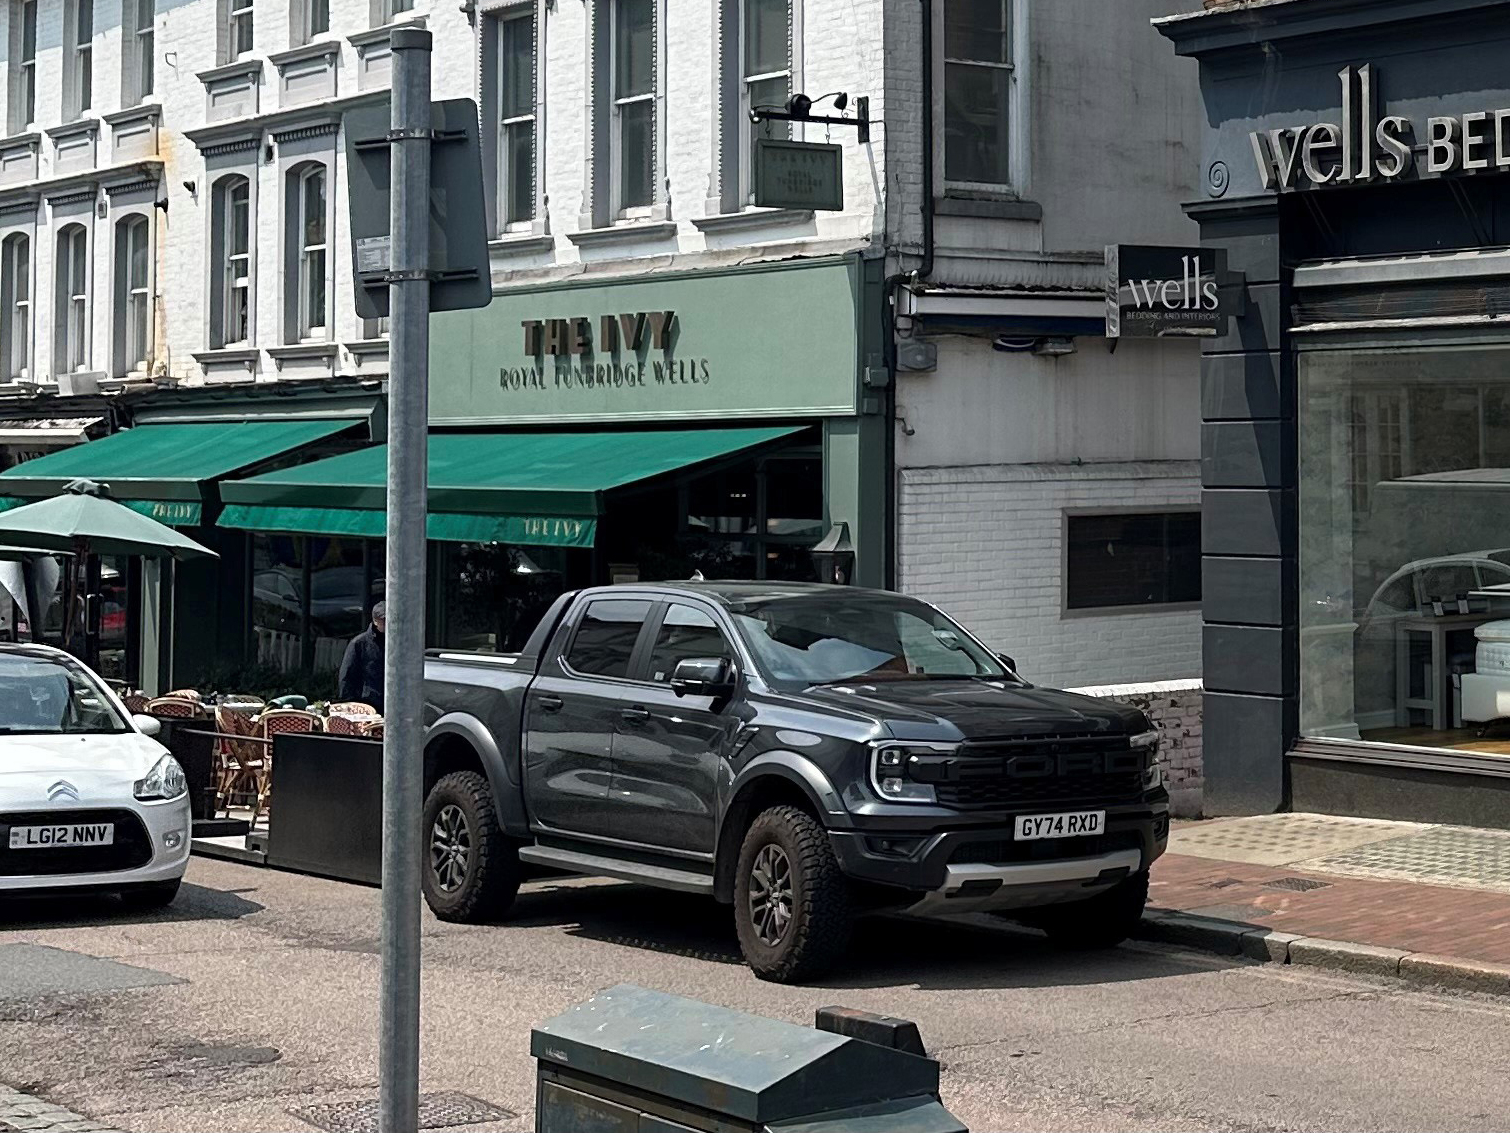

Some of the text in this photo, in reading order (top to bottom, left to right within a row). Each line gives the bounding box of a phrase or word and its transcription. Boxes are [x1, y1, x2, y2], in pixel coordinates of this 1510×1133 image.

[1249, 63, 1412, 190] wells
[1128, 255, 1219, 310] wells
[521, 310, 677, 356] THE IVY
[1164, 313, 1180, 321] AND
[500, 358, 710, 390] ROYAL TUNBRIDGE WELLS
[27, 826, 108, 844] LG12 NNV
[1022, 814, 1099, 837] GY74 RXD
